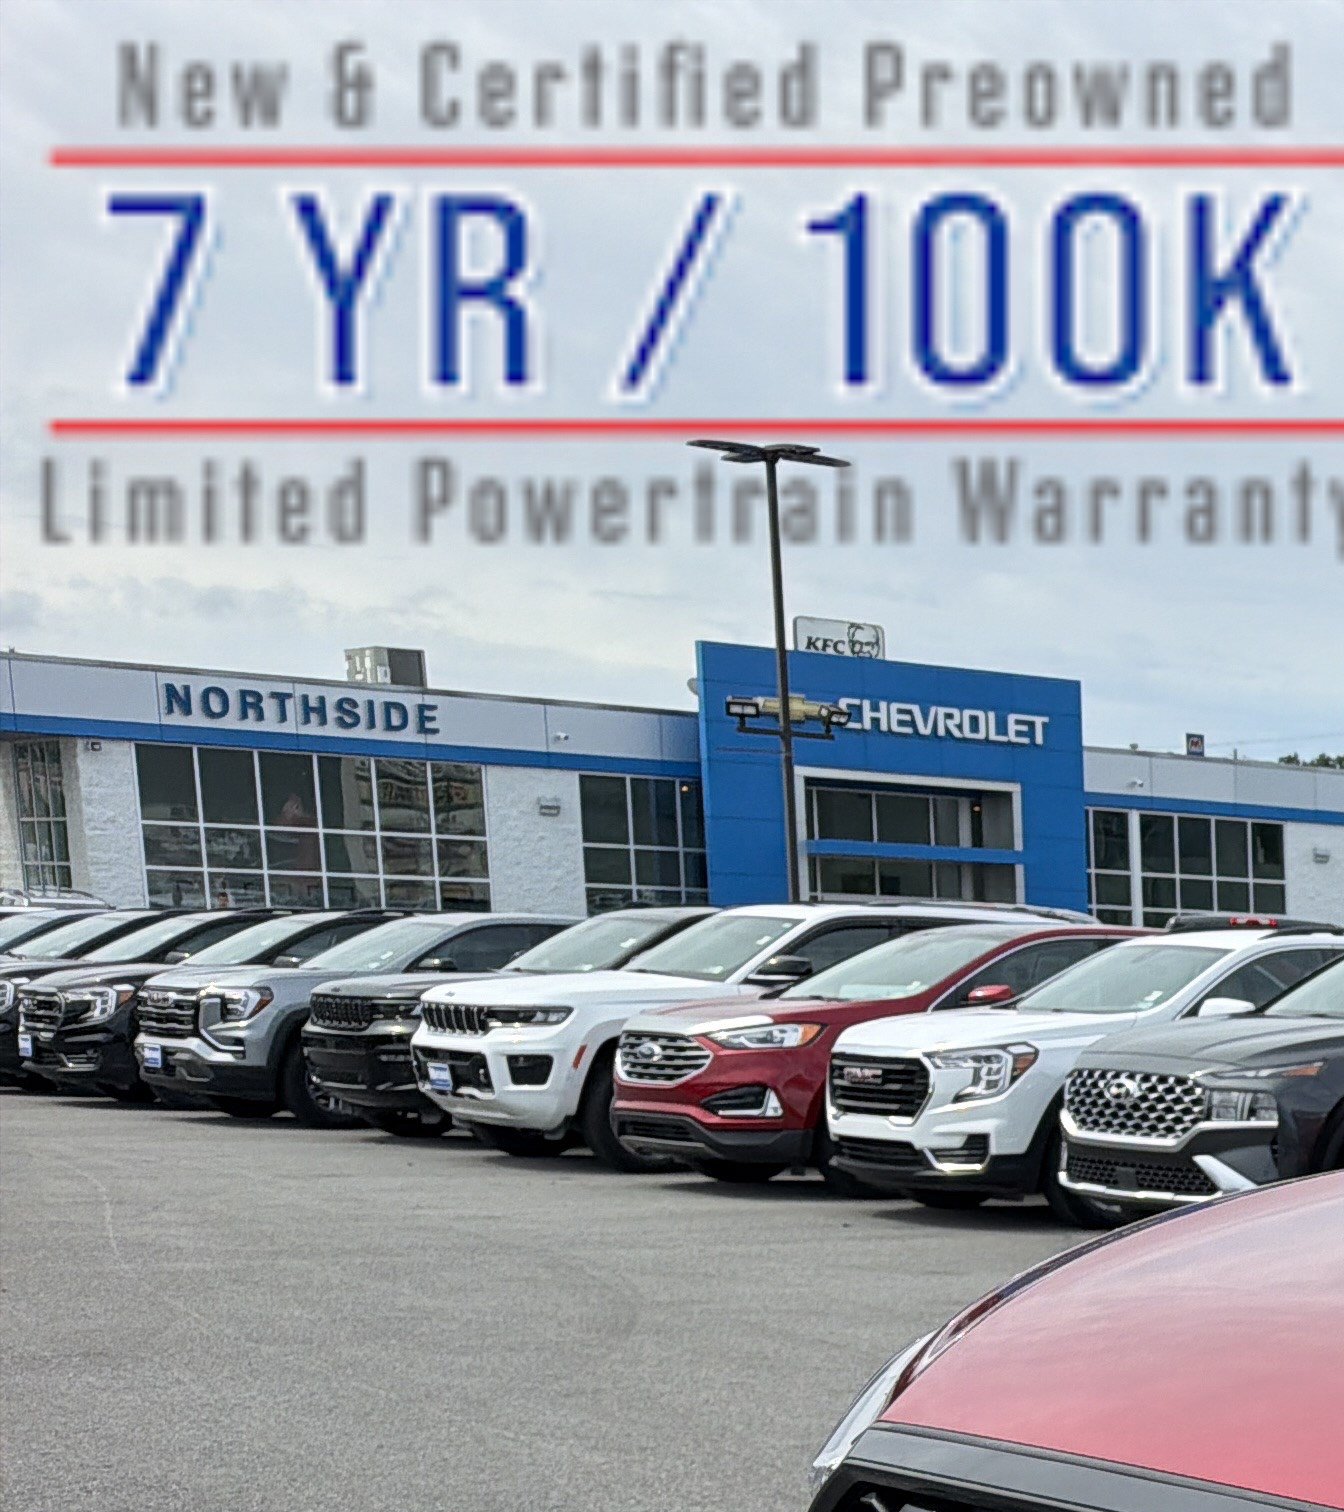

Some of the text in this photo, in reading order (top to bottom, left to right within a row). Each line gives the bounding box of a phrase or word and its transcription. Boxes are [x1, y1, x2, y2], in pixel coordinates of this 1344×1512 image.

[805, 636, 846, 656] KFC
[164, 682, 441, 736] NORTHSIDE
[838, 697, 1050, 746] CHEVROLET
